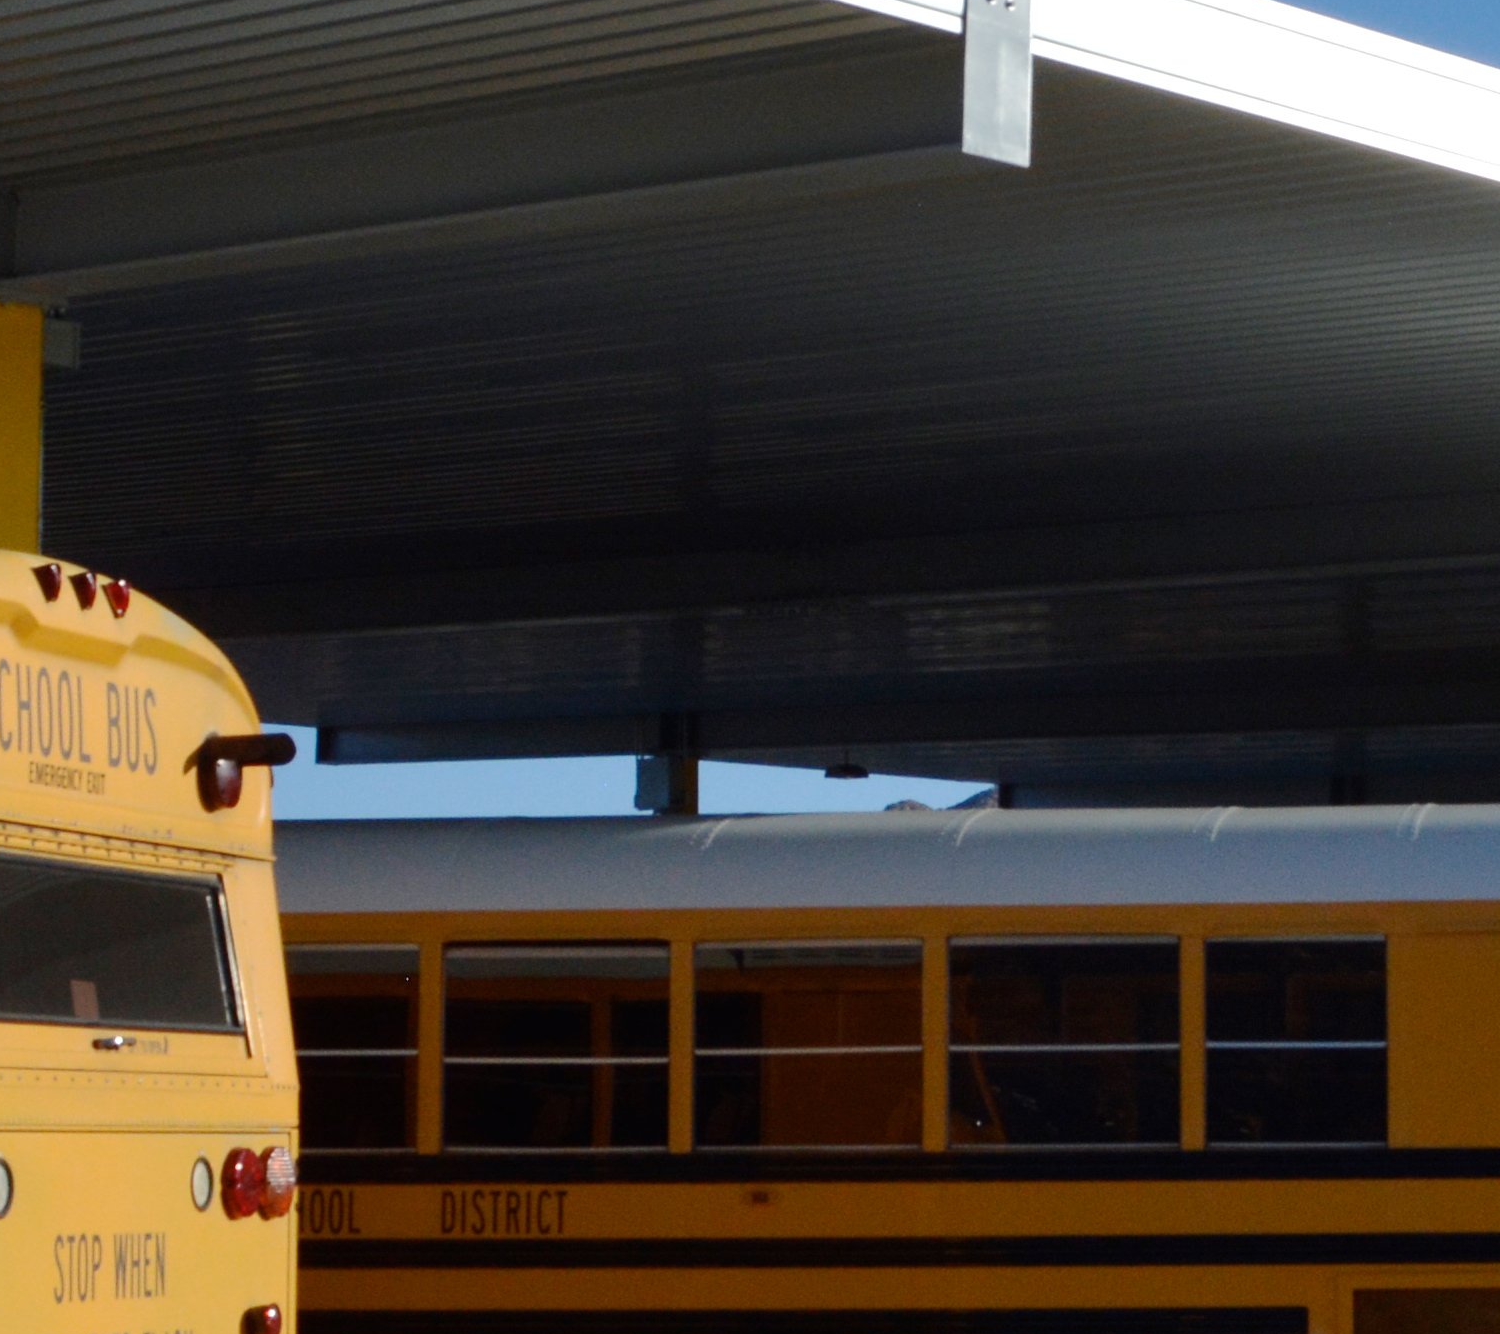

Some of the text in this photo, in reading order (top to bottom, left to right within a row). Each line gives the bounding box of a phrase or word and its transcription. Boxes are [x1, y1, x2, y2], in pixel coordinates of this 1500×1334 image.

[107, 682, 158, 776] BUS
[29, 761, 106, 795] EMERGENCY EXIT
[440, 1189, 569, 1235] DISTRICT
[54, 1232, 165, 1304] STOP WHEN
